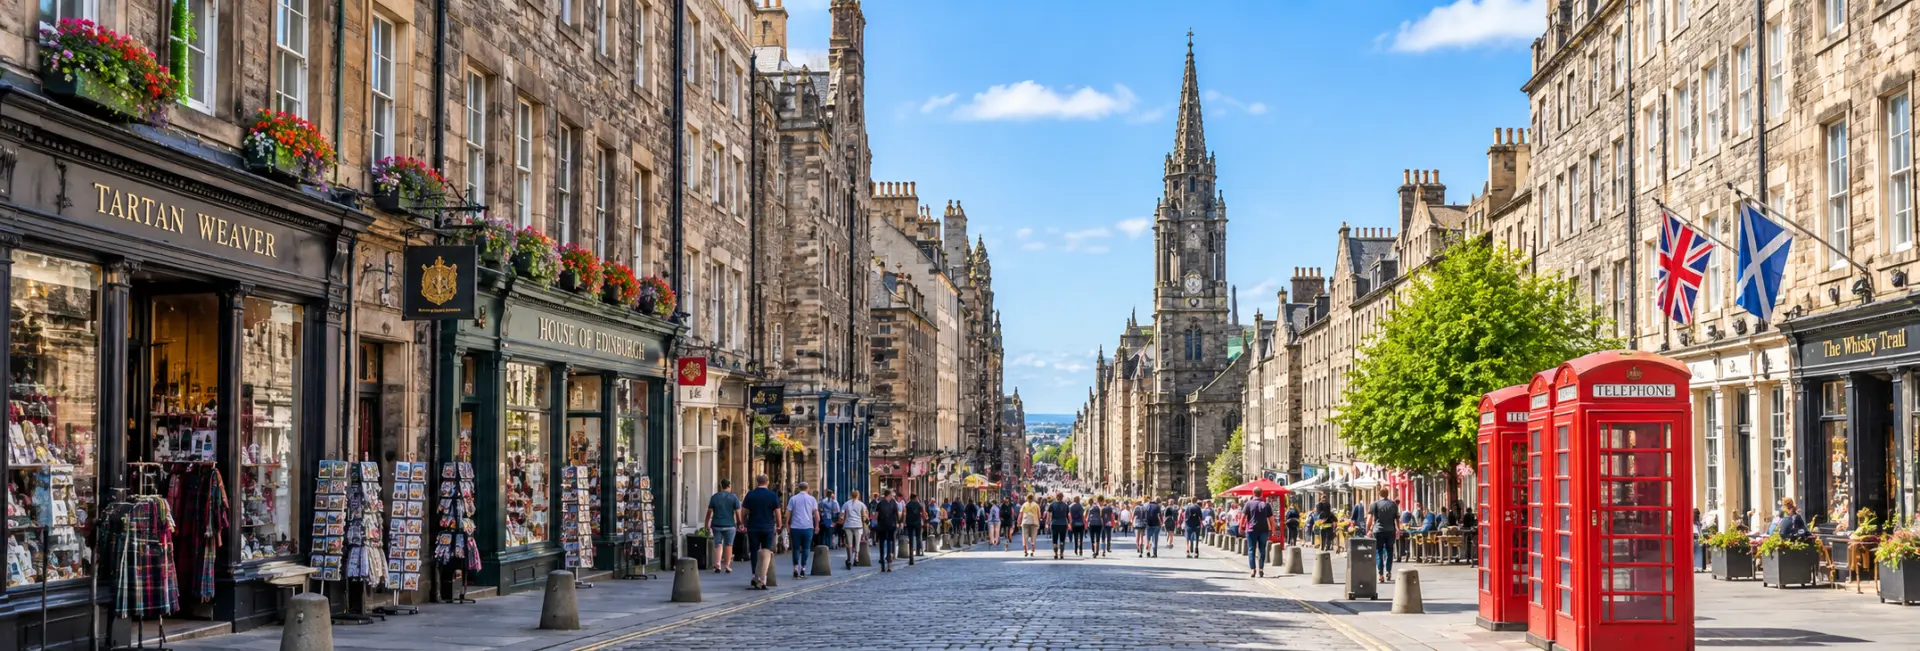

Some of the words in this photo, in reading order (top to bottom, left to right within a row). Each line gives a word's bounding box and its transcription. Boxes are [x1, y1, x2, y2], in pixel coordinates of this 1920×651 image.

[94, 183, 185, 234] TARTAN
[197, 212, 277, 257] WEAVER
[539, 317, 575, 346] HOUSE
[579, 327, 593, 349] OF
[595, 331, 645, 360] EDINBURGH
[1823, 340, 1840, 357] The
[1843, 333, 1877, 356] Whisky
[1879, 328, 1906, 349] Trail
[1596, 385, 1672, 396] TELEPHONE
